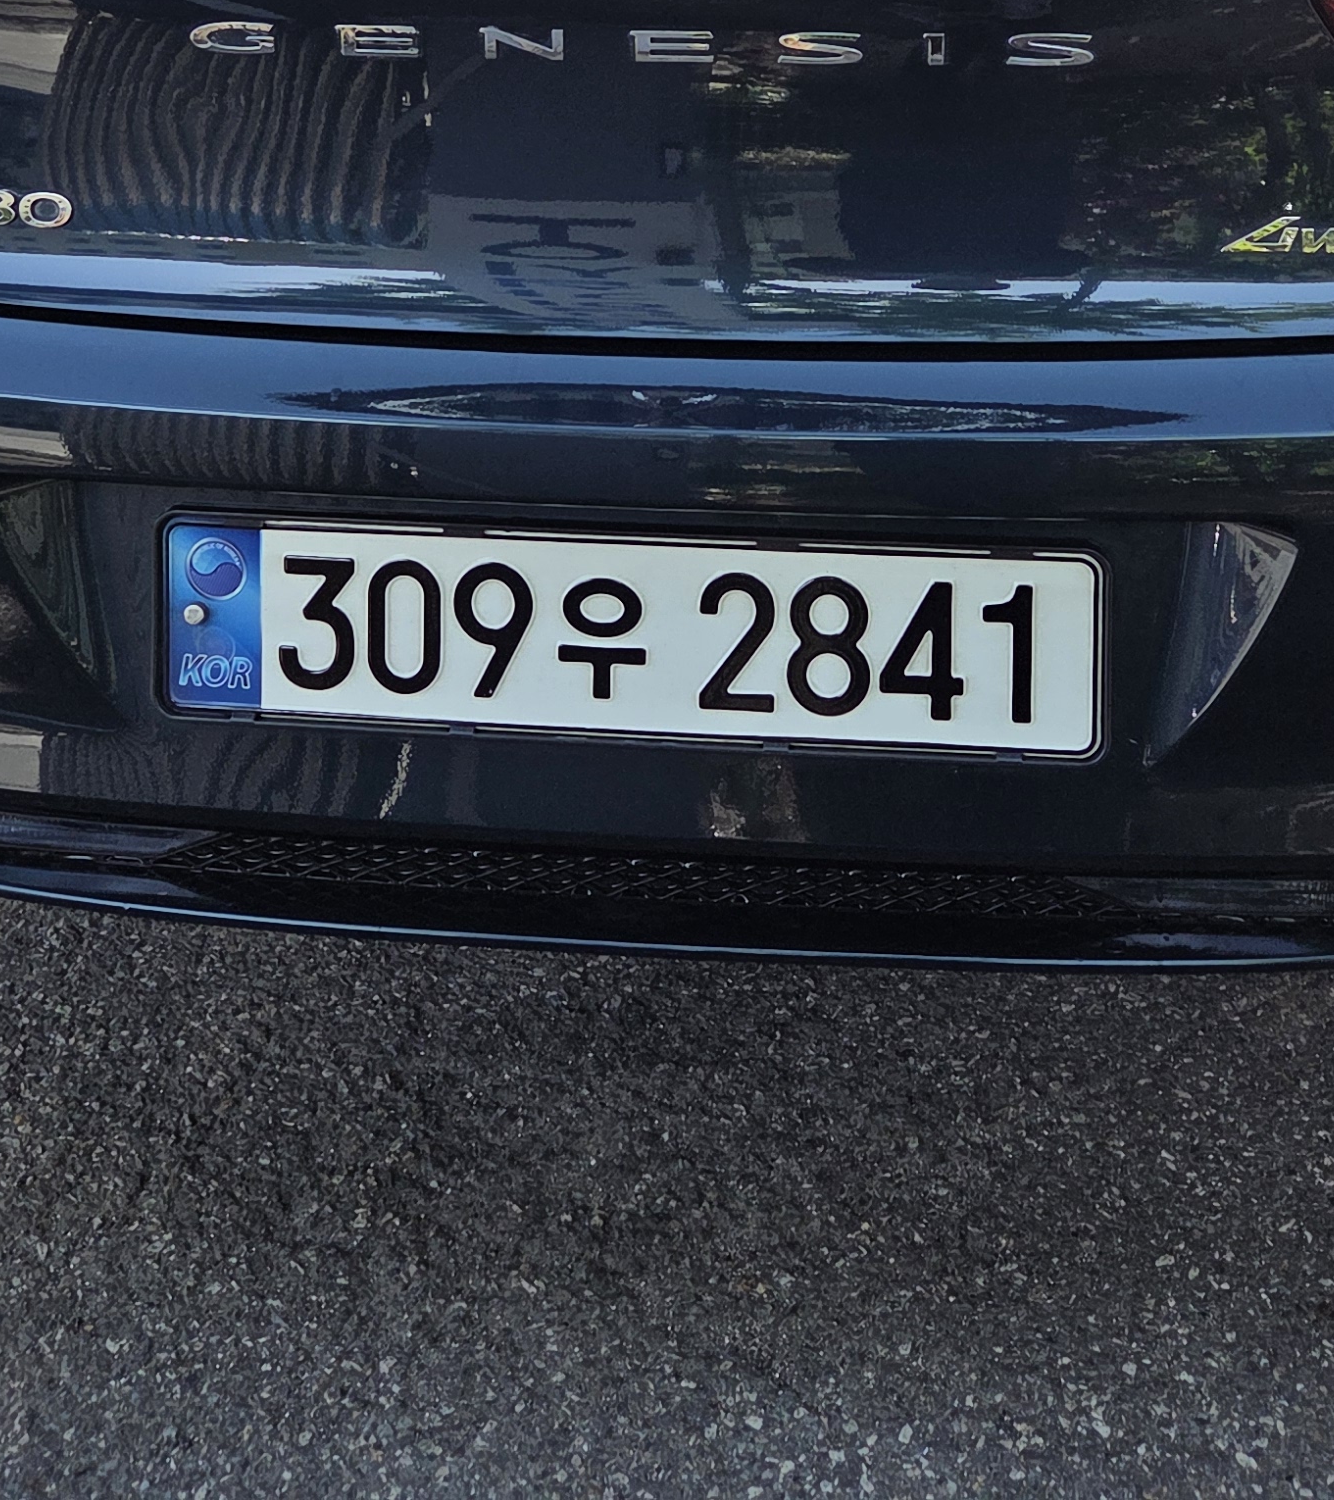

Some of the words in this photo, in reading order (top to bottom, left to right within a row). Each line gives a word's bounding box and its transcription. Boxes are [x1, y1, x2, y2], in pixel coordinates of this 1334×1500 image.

[189, 20, 1096, 68] GENESIS
[277, 553, 648, 700] 309우
[697, 571, 1035, 725] 2841
[178, 653, 253, 690] KOR
